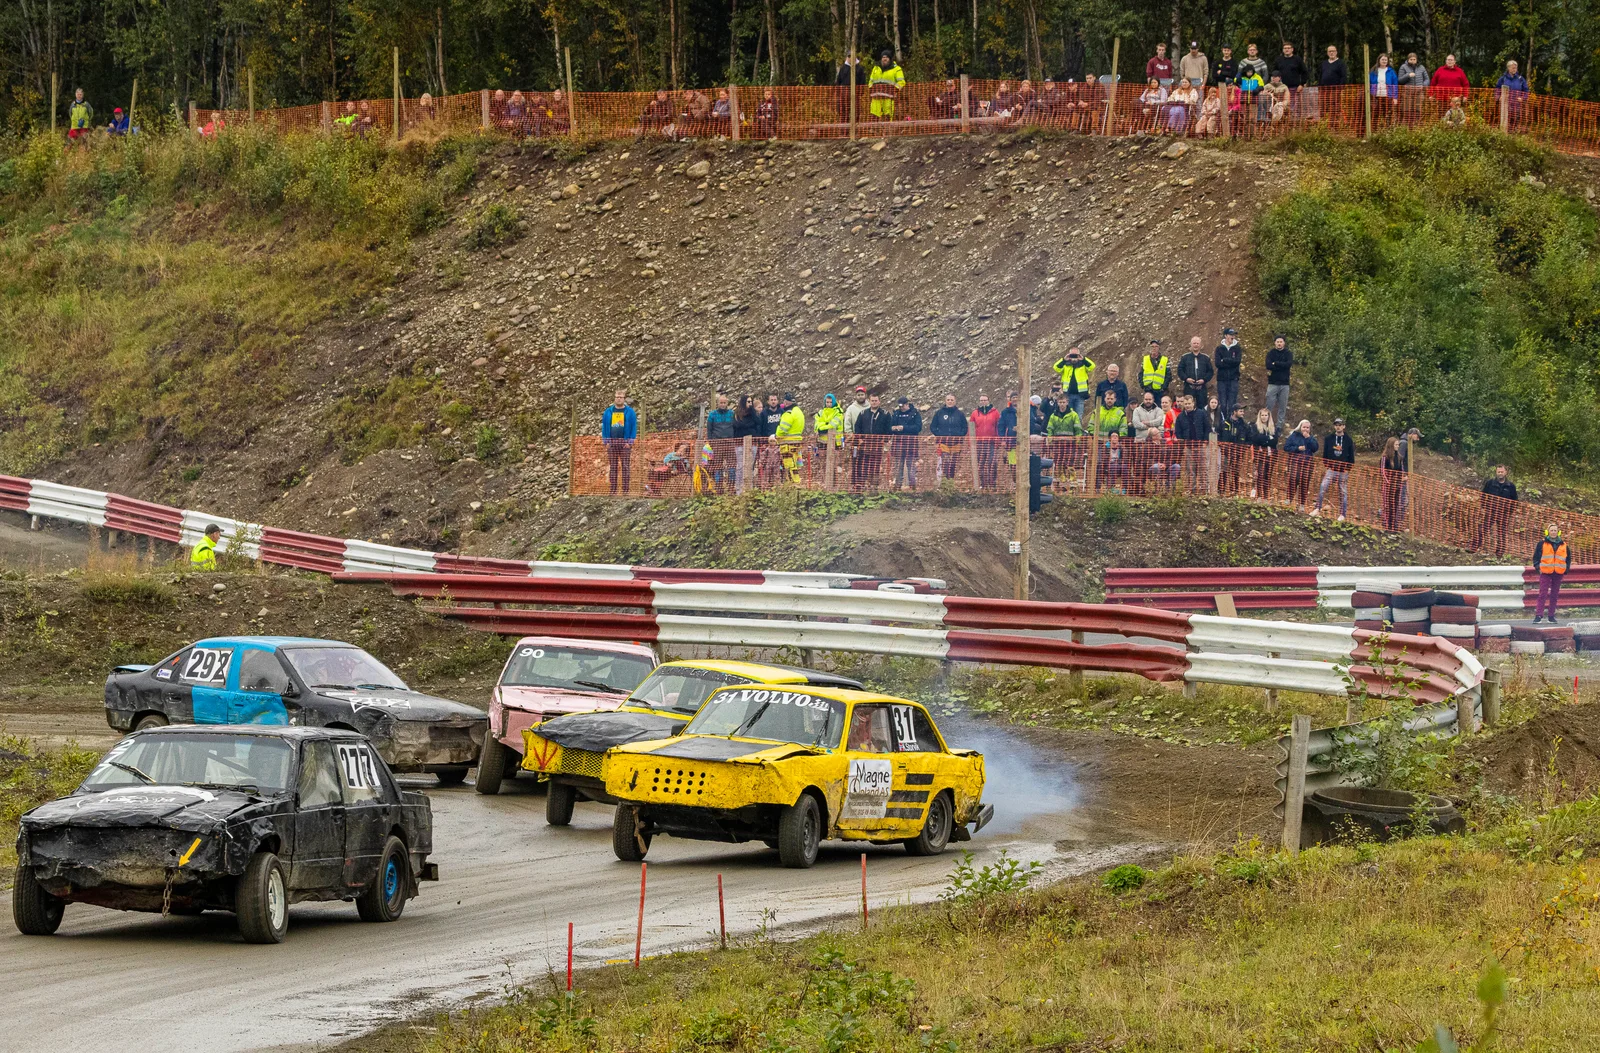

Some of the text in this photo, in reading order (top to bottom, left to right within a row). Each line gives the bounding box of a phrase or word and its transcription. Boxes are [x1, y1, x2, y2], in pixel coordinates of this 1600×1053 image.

[186, 650, 232, 682] 292
[520, 648, 545, 658] 90
[714, 692, 739, 704] 31
[740, 690, 811, 706] VOLVO
[894, 707, 914, 741] 31
[340, 747, 376, 787] 277
[855, 762, 890, 788] Magne
